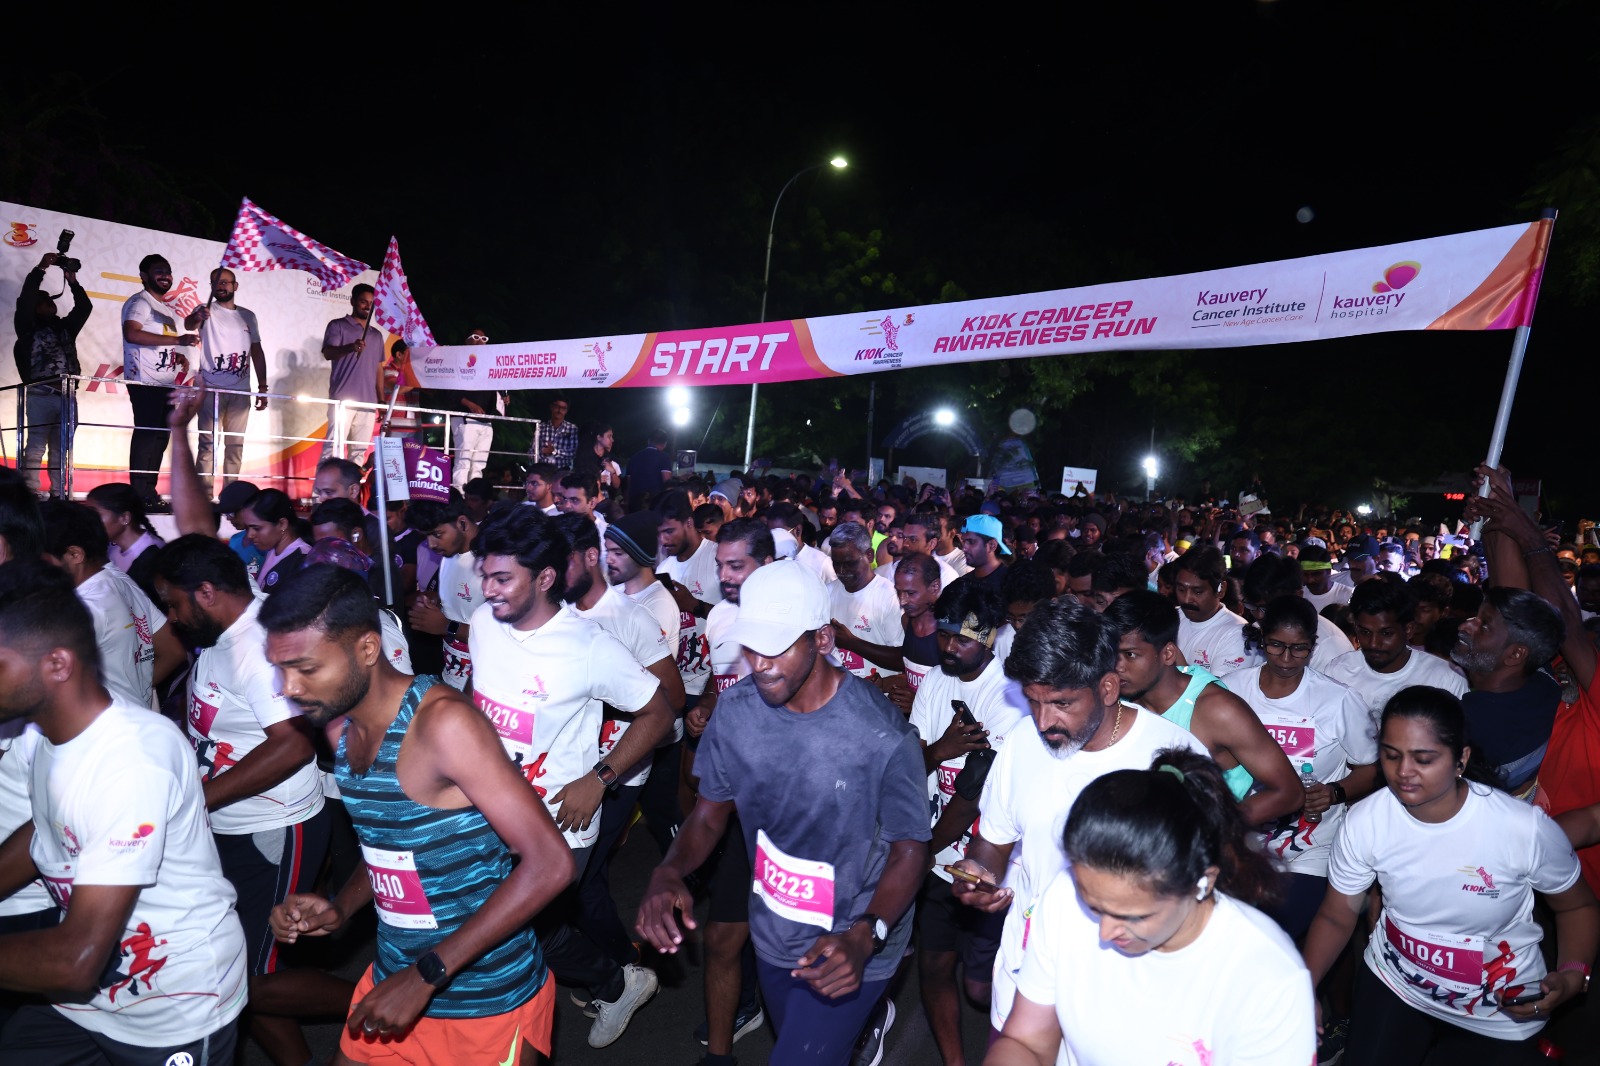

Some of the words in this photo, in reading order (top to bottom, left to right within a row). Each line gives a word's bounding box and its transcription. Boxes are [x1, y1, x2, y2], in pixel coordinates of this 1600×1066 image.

[329, 290, 352, 301] Institut
[1197, 287, 1268, 306] Kauvery
[1332, 291, 1406, 310] kauvery
[959, 311, 1018, 333] K10K
[1020, 300, 1134, 327] CANCER
[1192, 306, 1241, 322] Cancer
[1243, 300, 1306, 317] Institute
[1223, 319, 1239, 327] New
[1240, 317, 1256, 327] Age
[1256, 315, 1283, 325] Cancer
[1284, 313, 1304, 322] Care
[1330, 306, 1389, 319] hospital
[932, 323, 1091, 354] AWARENESS
[1092, 316, 1158, 340] RUN
[495, 355, 516, 366] K10K
[517, 353, 557, 366] CANCER
[650, 332, 789, 376] START
[854, 347, 886, 361] K10K
[488, 366, 544, 379] AWARENESS
[545, 366, 568, 378] RUN
[415, 460, 443, 482] 50
[409, 479, 449, 493] minutes
[481, 699, 519, 730] 14276
[109, 837, 148, 849] kauvery
[763, 859, 815, 900] 12223
[1462, 884, 1486, 893] K10K
[1399, 934, 1454, 970] 11061
